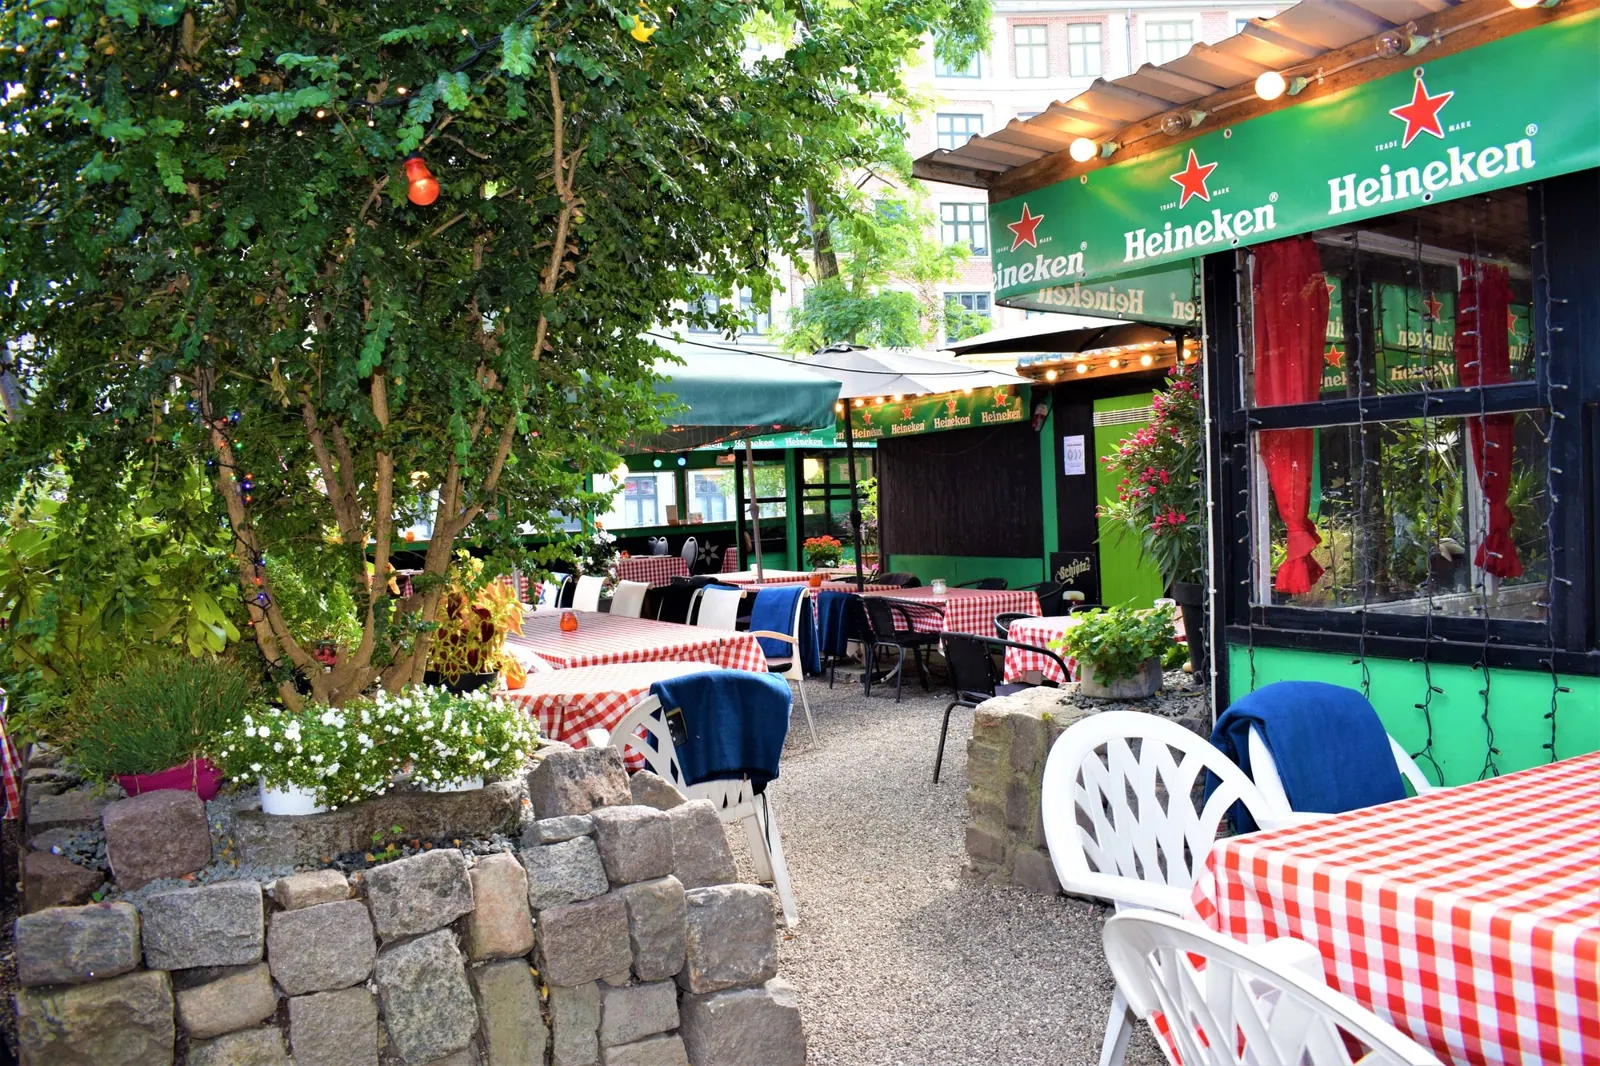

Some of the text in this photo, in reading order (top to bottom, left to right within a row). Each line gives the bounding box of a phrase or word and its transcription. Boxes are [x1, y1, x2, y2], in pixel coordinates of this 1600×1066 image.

[1375, 120, 1472, 152] TRADE MARK
[1328, 138, 1536, 215] Heineken
[1123, 203, 1277, 263] Heineken
[891, 422, 925, 435] Heineken
[934, 415, 971, 429] Heineken
[981, 409, 1021, 424] Heineken
